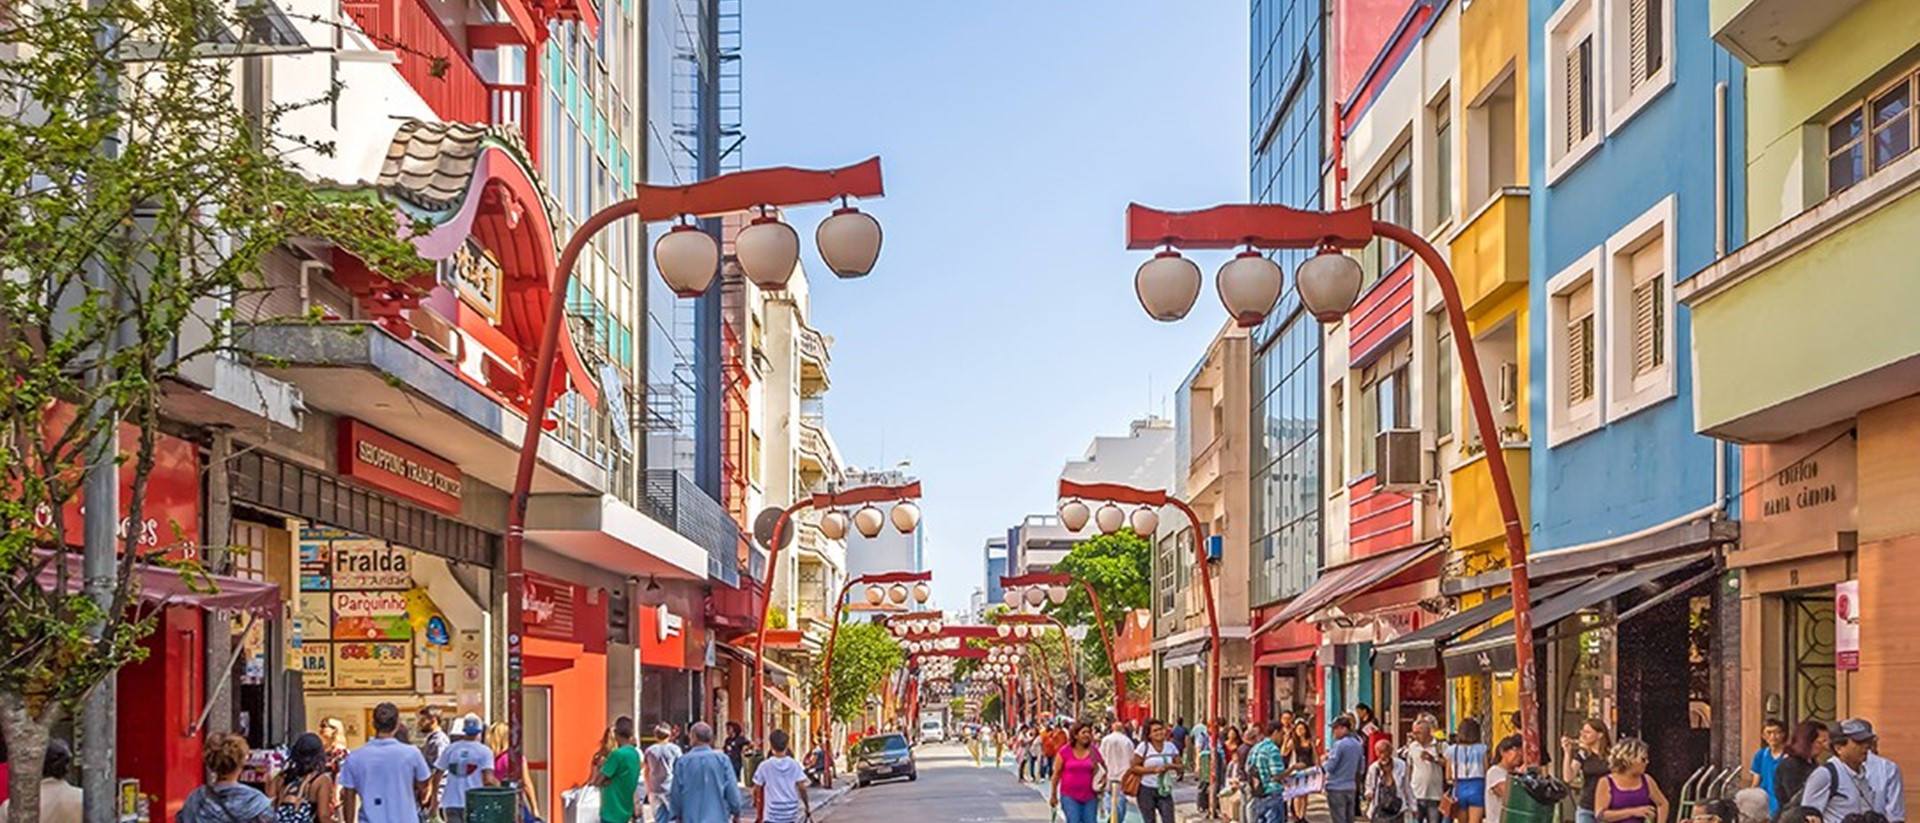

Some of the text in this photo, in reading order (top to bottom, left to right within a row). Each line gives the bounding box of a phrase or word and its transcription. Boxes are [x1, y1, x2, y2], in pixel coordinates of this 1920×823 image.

[359, 440, 405, 476] SHOPPING
[406, 460, 434, 488] TRADE
[1763, 496, 1791, 517] MARIA
[336, 549, 406, 573] Fralda
[338, 594, 408, 617] Parquinho
